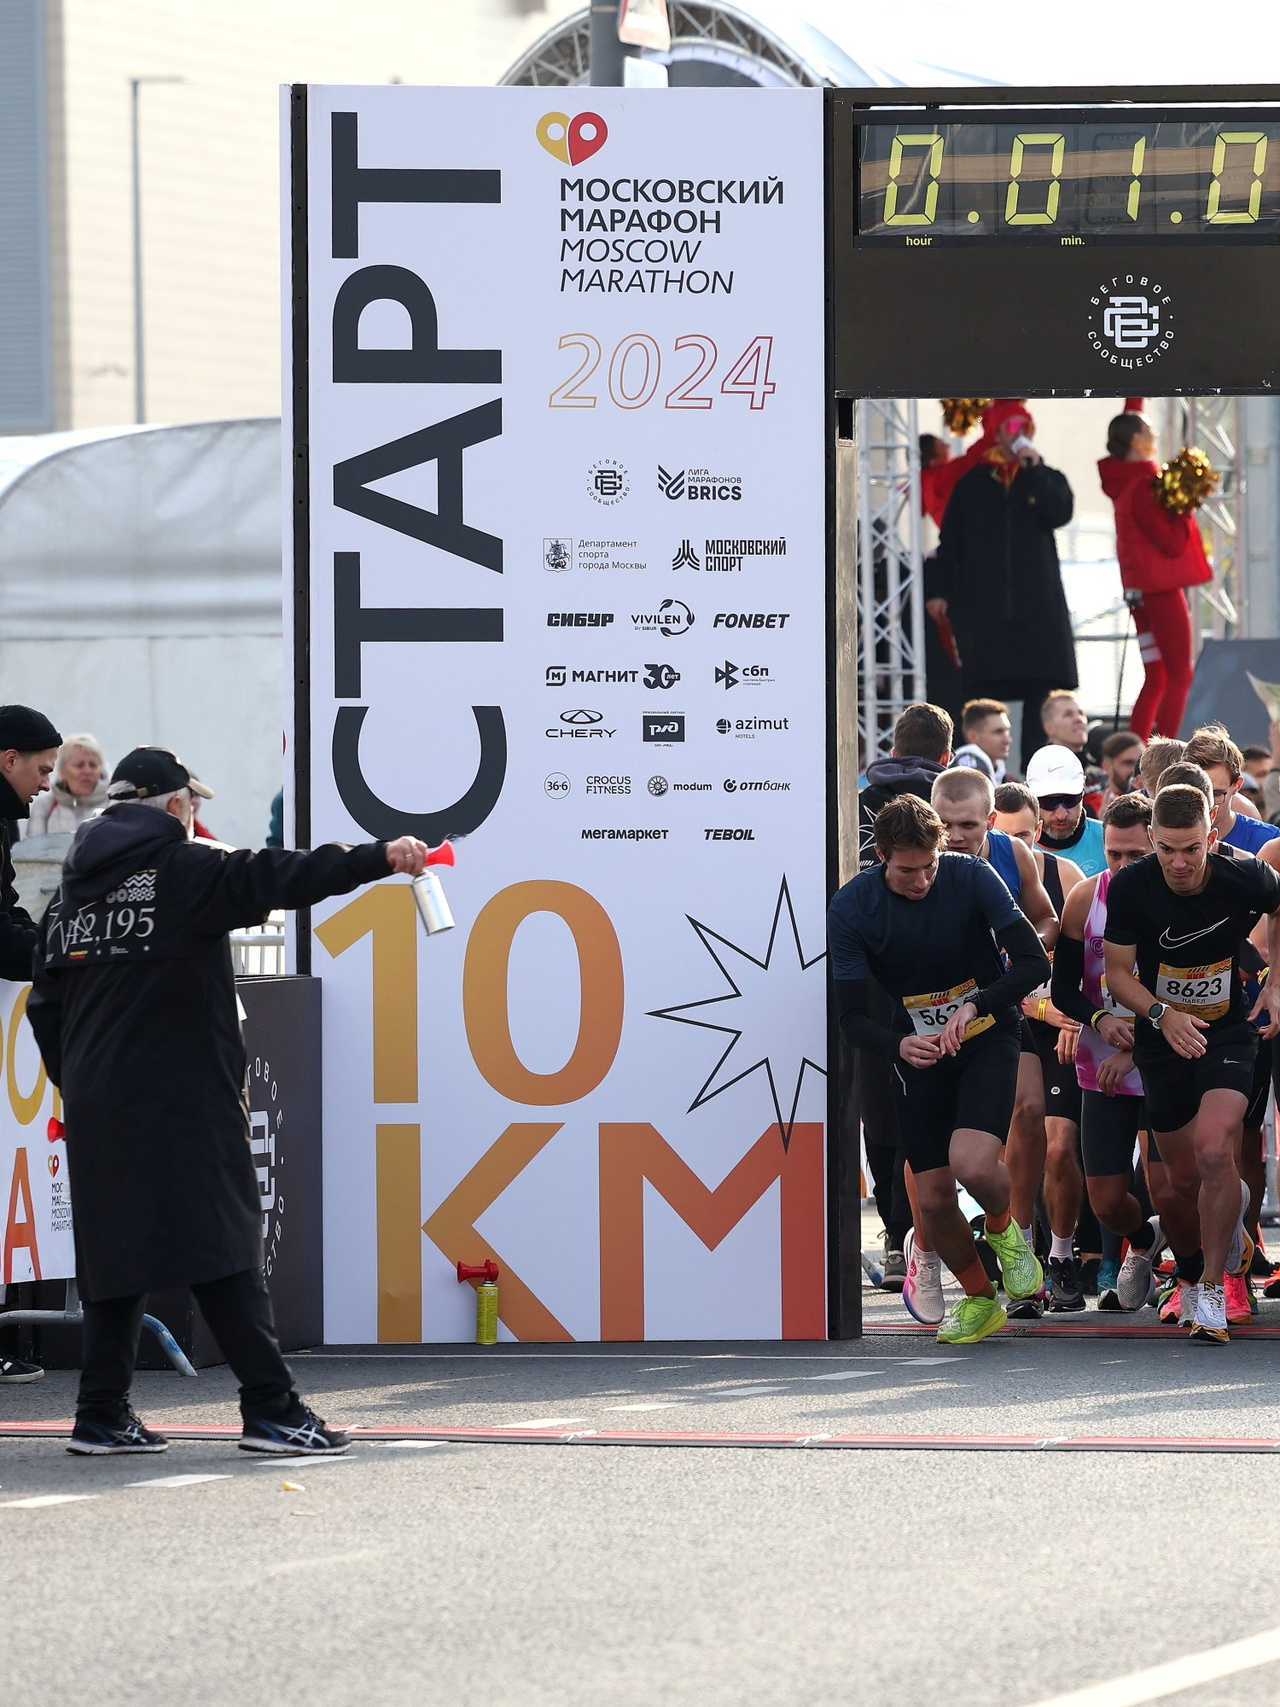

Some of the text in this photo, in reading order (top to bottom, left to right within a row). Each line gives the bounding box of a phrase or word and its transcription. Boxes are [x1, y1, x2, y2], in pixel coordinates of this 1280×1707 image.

[560, 176, 784, 204] МОСКОВСКИЙ
[560, 209, 721, 234] МАРАФОН
[906, 235, 932, 246] hour
[1061, 235, 1085, 246] min.
[560, 239, 702, 263] MOSCOW
[560, 269, 734, 294] MARATHON
[1089, 274, 1172, 306] БЕГОВОЕ
[1086, 330, 1175, 369] СООБЩЕСТВО
[548, 333, 777, 410] 2024
[587, 458, 629, 475] БЕГОВОЕ
[331, 111, 508, 846] СТАРТ
[586, 486, 631, 506] СООБЩЕСТВО
[688, 486, 742, 500] BRICS
[578, 539, 638, 549] Департамент
[705, 537, 787, 556] МОСКОВСКИЙ
[578, 551, 609, 559] спорта
[578, 561, 647, 571] города Москвы
[705, 557, 743, 571] СПОРТ
[547, 613, 614, 627] СИБУР
[631, 614, 681, 624] VIVILEN
[713, 613, 790, 628] FONBET
[572, 671, 639, 682] МАГНИТ
[742, 665, 769, 676] сбп
[735, 716, 789, 730] azimut
[545, 729, 617, 738] CHERY
[586, 776, 632, 785] CROCUS
[673, 782, 713, 791] modum
[581, 829, 669, 841] мегамаркет
[704, 829, 755, 840] TEBOIL
[312, 878, 625, 1107] 10
[1166, 977, 1222, 998] 8623
[375, 1122, 826, 1344] КМ
